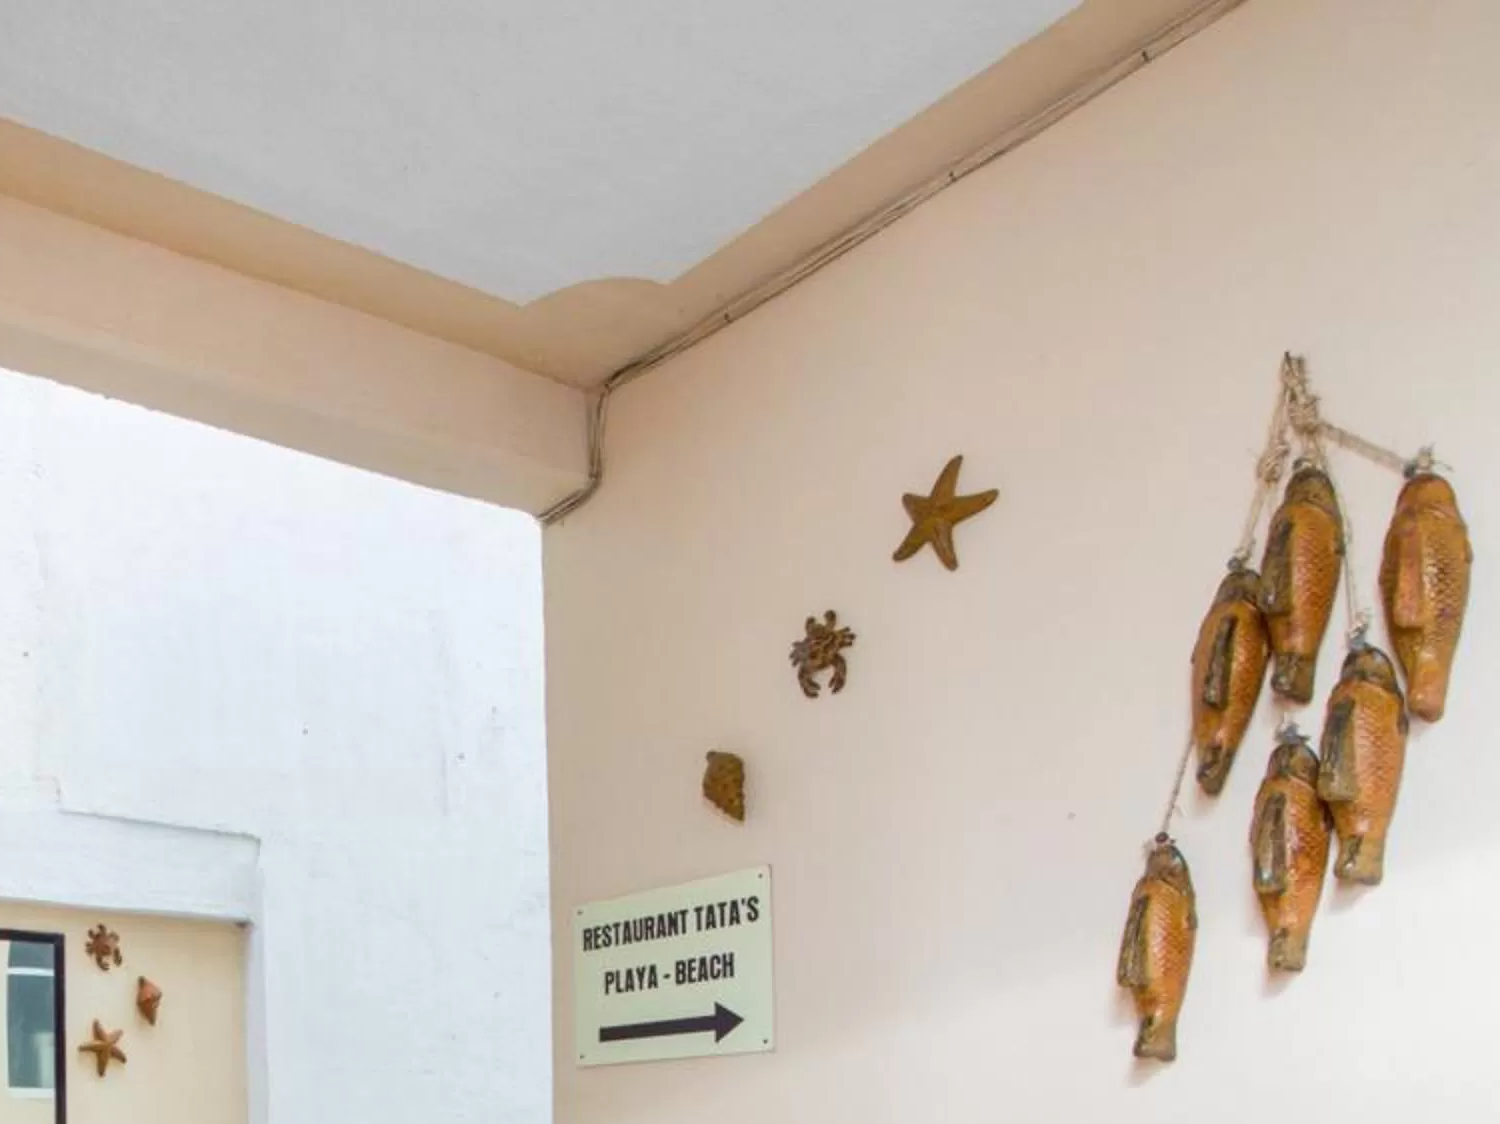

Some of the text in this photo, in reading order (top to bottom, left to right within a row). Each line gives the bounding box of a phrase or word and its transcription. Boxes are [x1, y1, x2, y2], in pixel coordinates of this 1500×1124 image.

[582, 896, 760, 952] RESTAURANT TATA'S
[604, 964, 659, 995] PLAYA
[675, 952, 735, 985] BEACH
